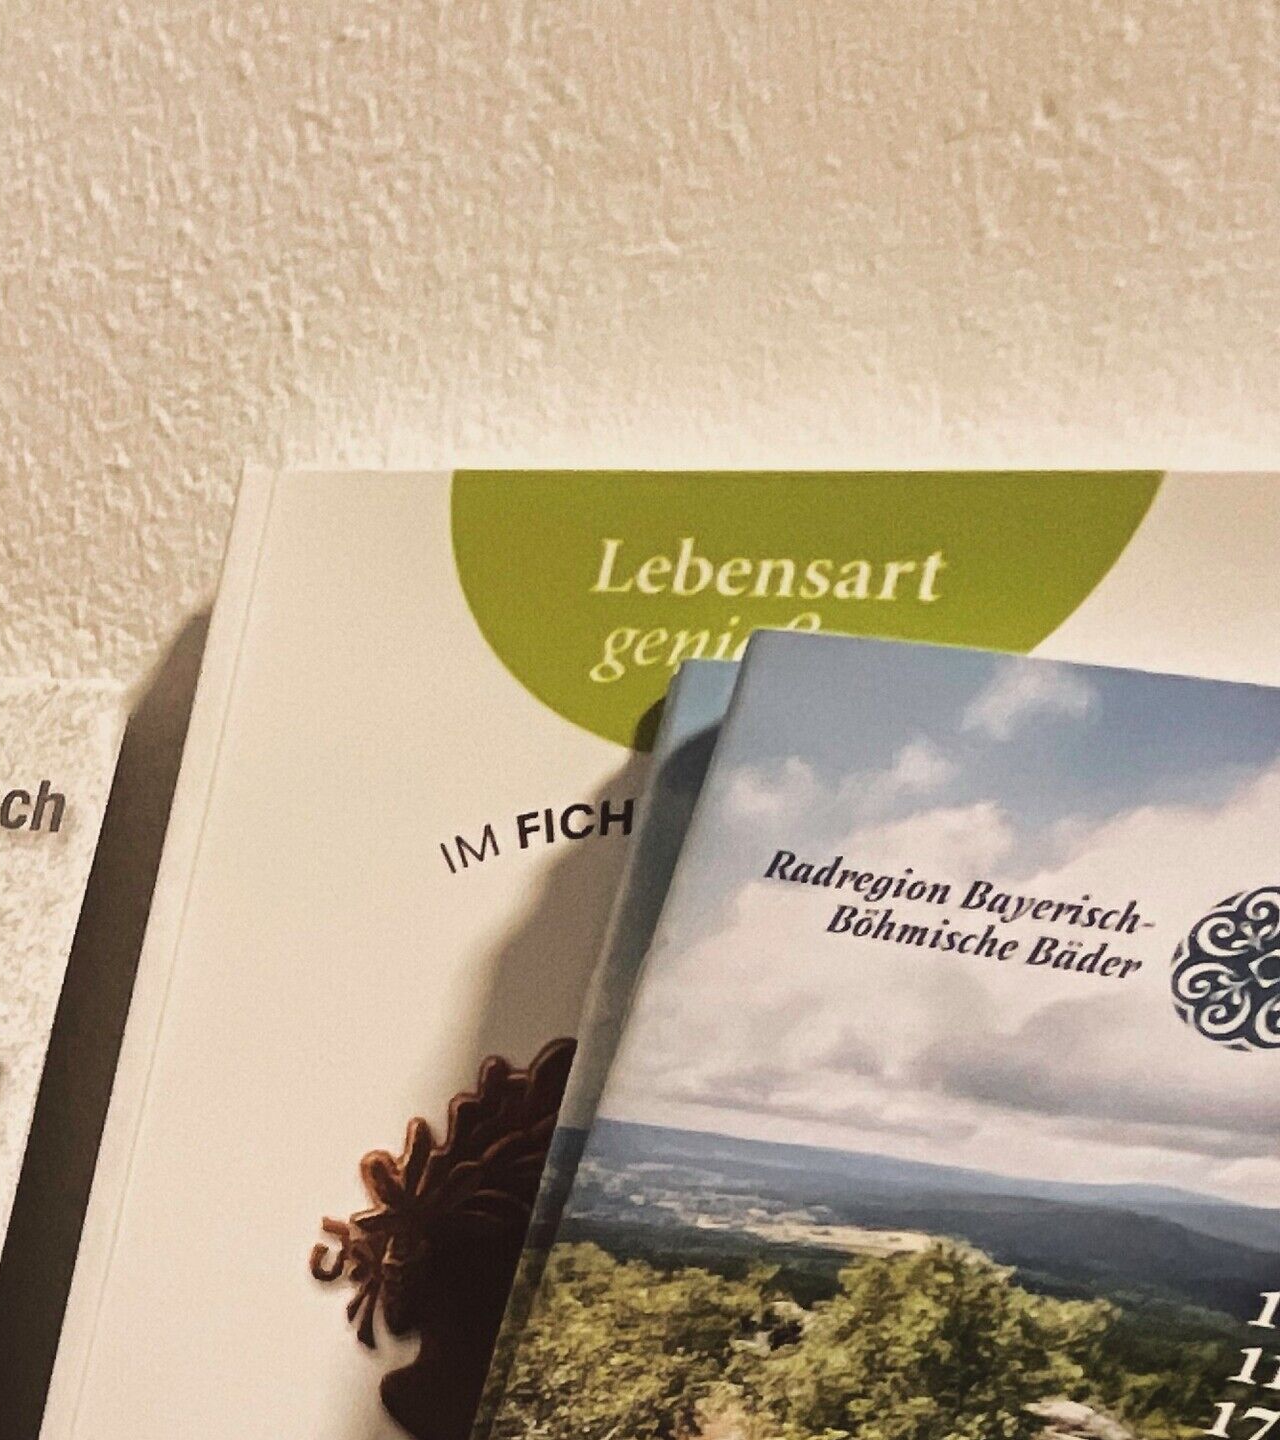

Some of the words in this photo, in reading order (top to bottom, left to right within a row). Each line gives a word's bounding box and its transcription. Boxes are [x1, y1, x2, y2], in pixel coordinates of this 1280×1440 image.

[589, 537, 951, 604] Lebensart
[589, 612, 822, 684] geni
[438, 823, 502, 875] IM
[514, 799, 636, 850] FICH
[762, 848, 952, 908] Radregion
[958, 878, 1157, 936] Bayerisch-
[825, 903, 1021, 963] Böhmische
[1024, 931, 1145, 984] Bäder
